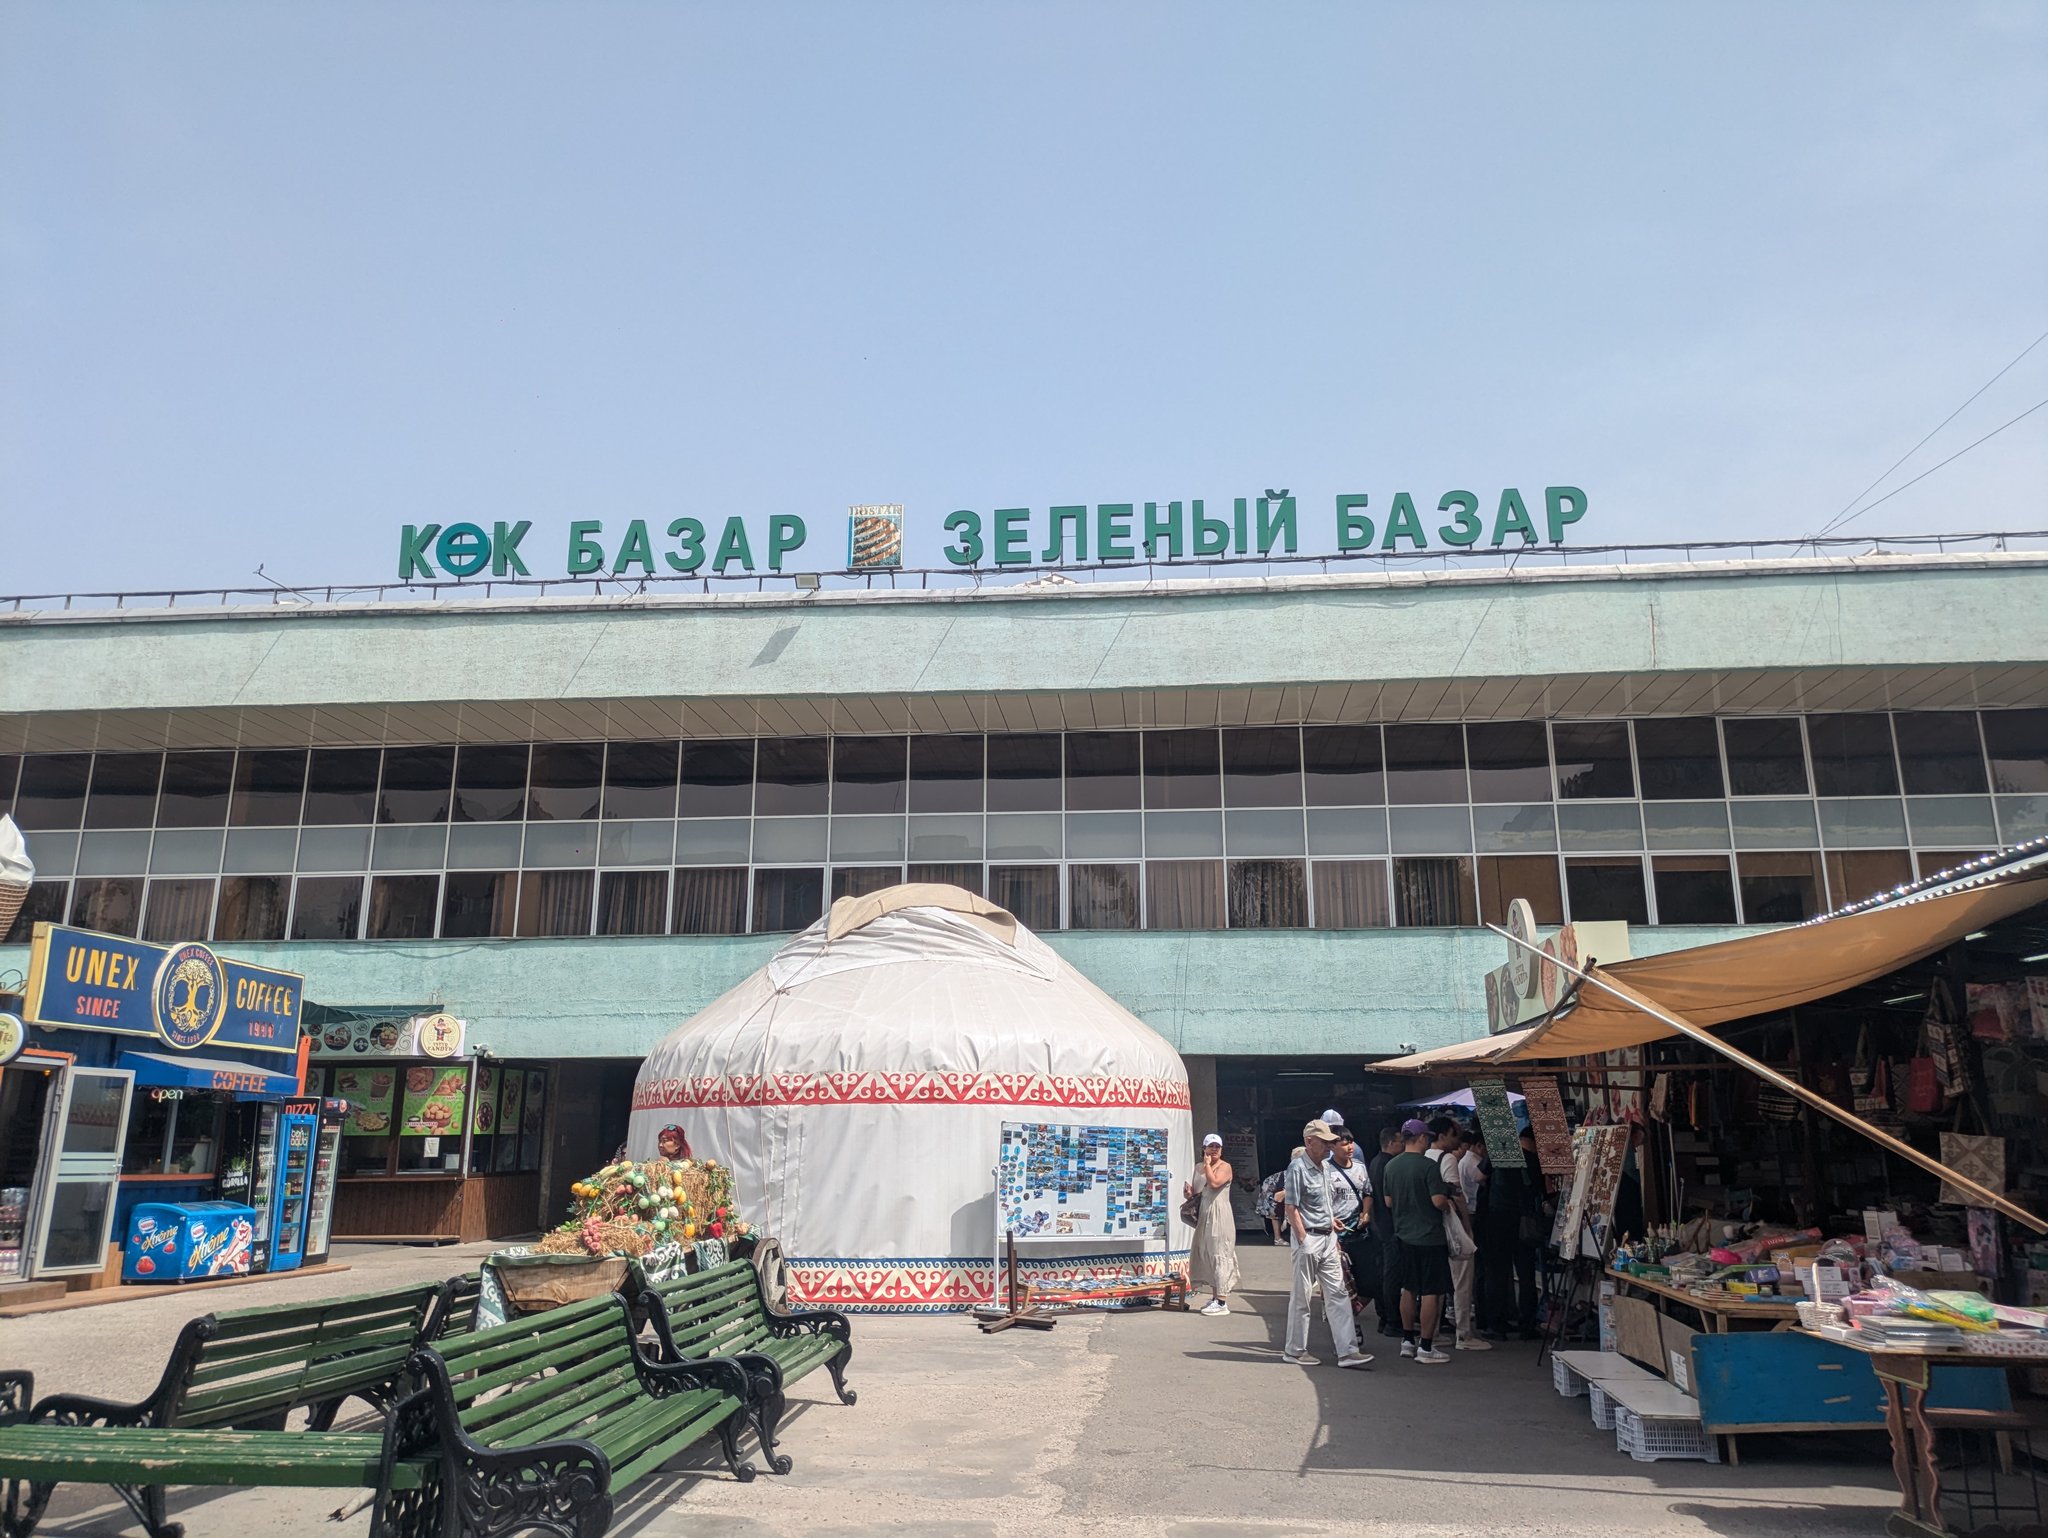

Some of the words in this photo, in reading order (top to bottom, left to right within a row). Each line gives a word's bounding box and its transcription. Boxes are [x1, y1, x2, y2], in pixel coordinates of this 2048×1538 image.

[399, 519, 532, 579] КӨК
[567, 514, 807, 576] БАЗАР
[943, 489, 1298, 566] ЗЕЛЕНЫЙ
[1336, 486, 1588, 551] БАЗАР
[66, 946, 140, 991] UNEX
[236, 977, 294, 1017] COFFEE
[76, 995, 121, 1019] SINCE
[150, 1088, 184, 1103] open
[212, 1071, 269, 1093] COFFEE
